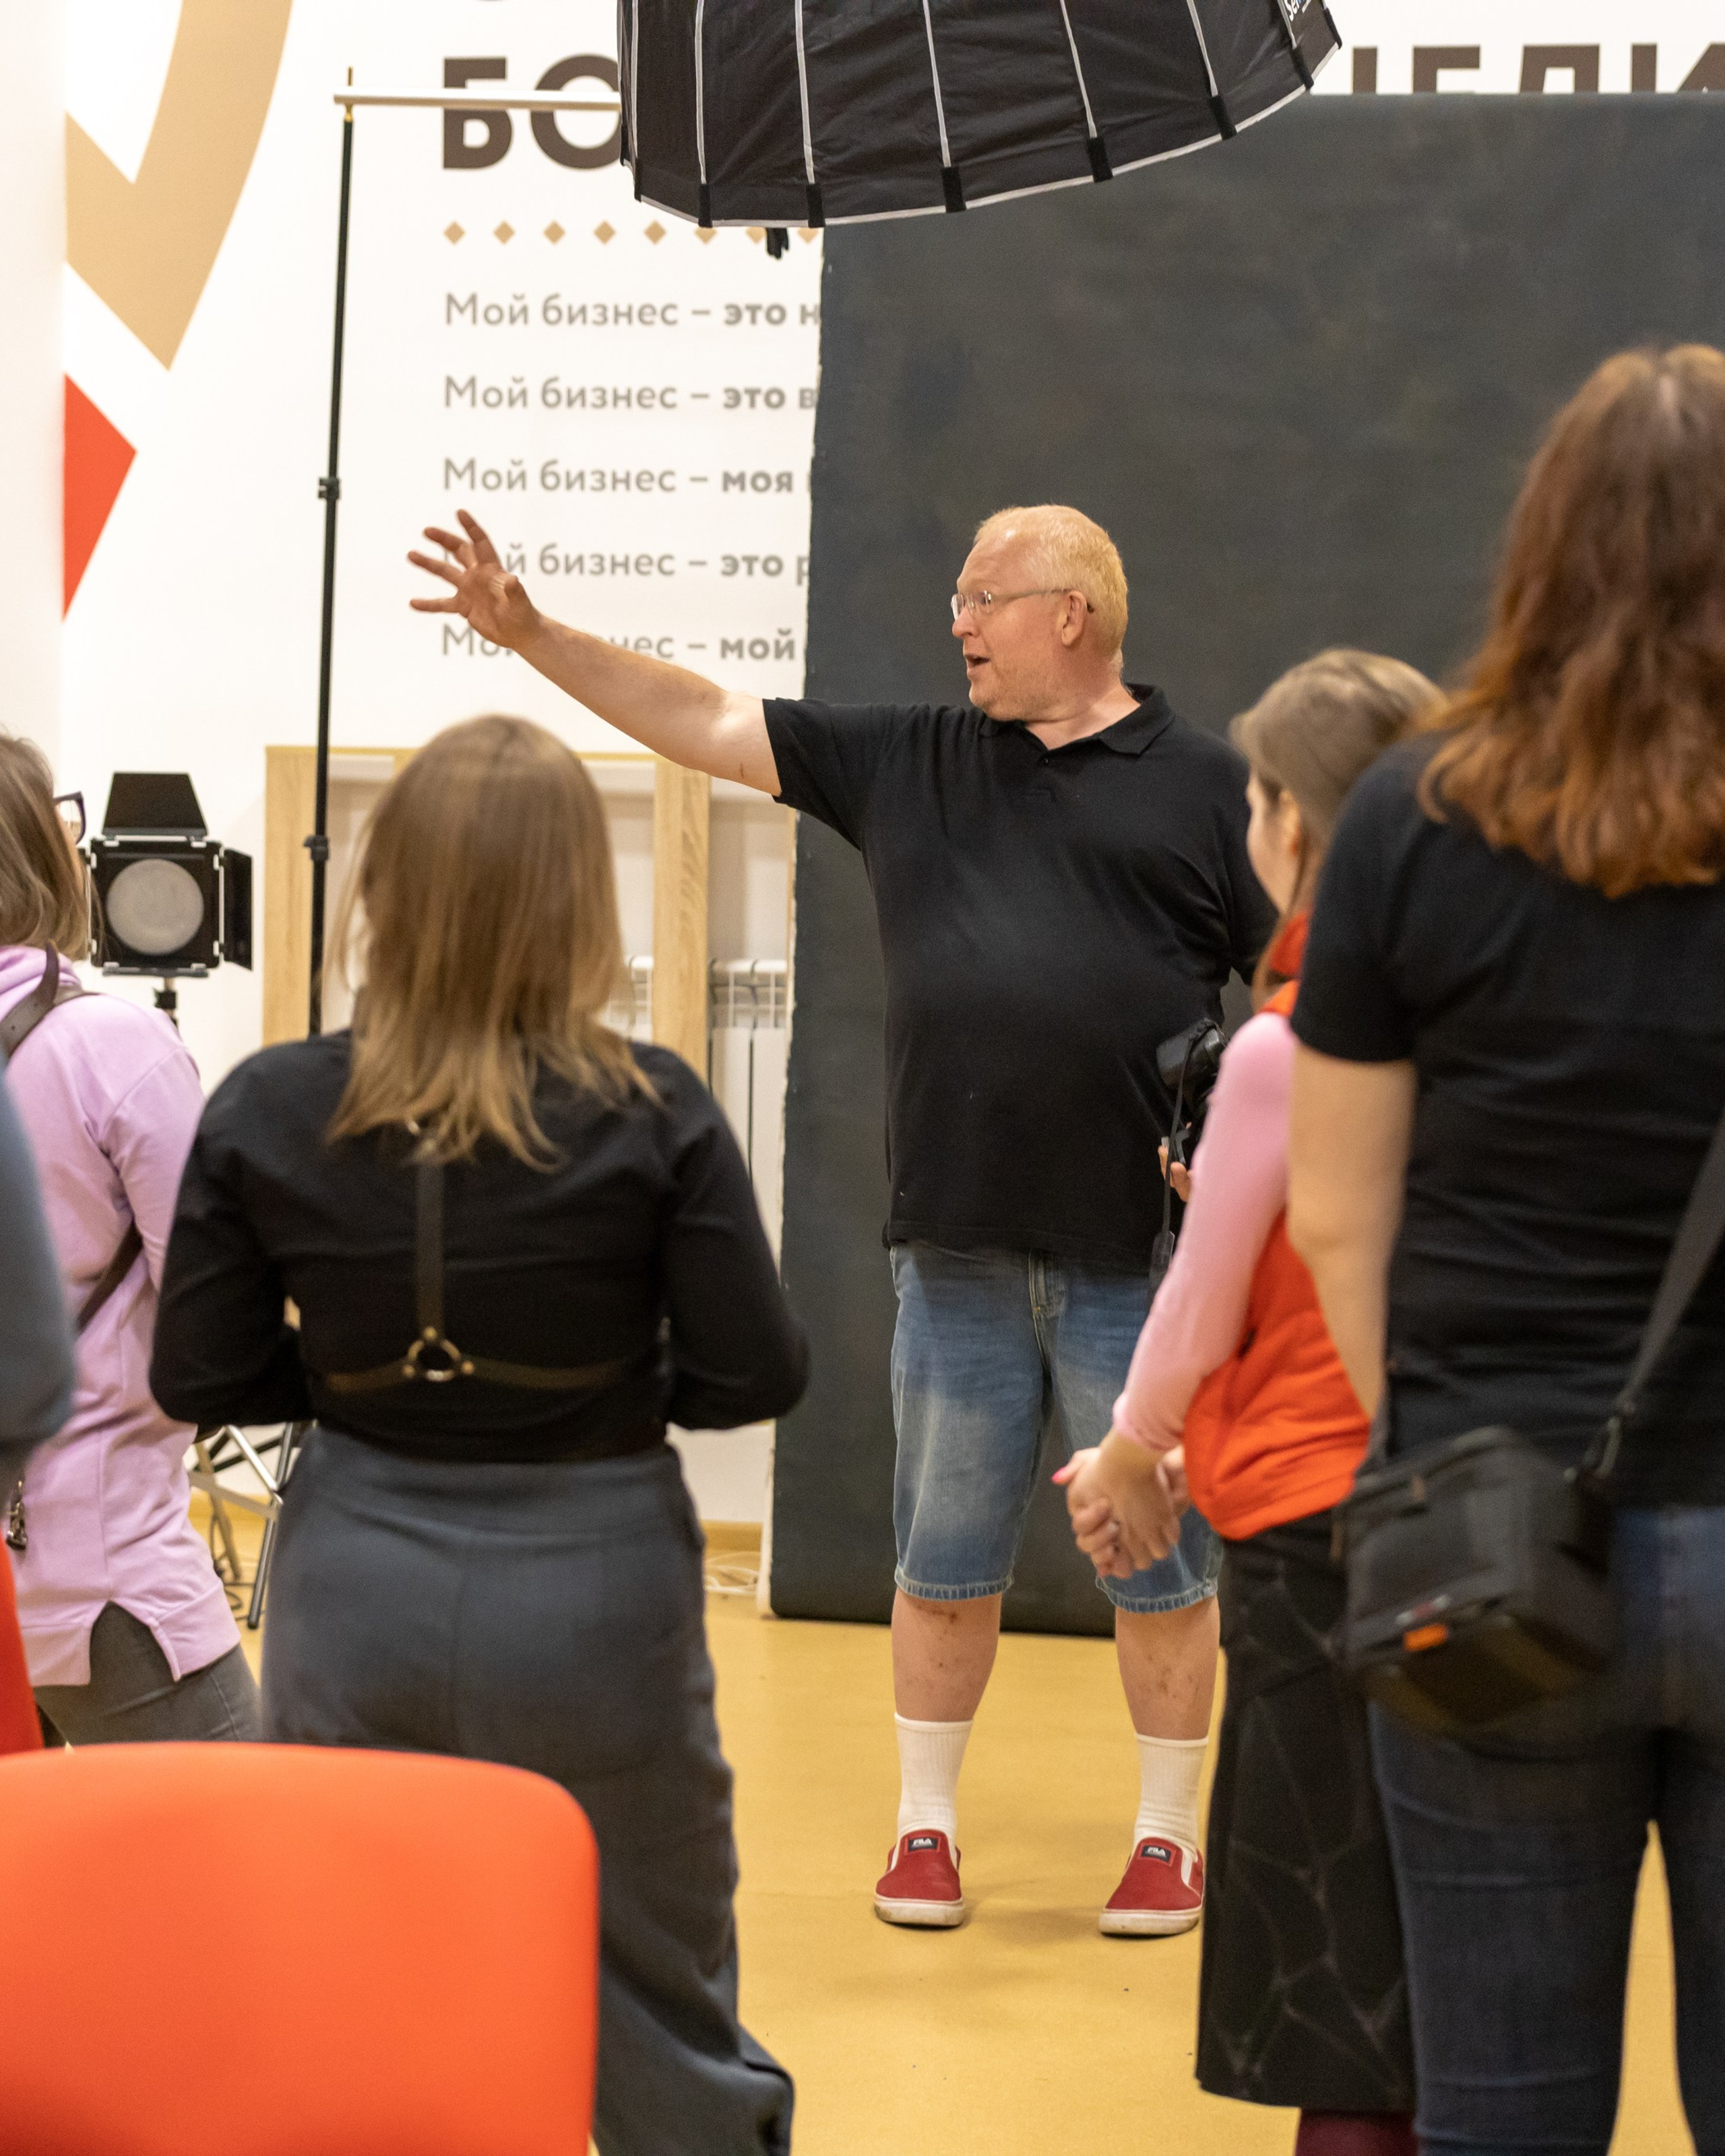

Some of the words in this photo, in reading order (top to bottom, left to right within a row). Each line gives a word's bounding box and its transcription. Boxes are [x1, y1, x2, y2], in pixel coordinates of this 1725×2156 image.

[445, 292, 529, 326] Мой
[541, 292, 679, 327] бизнес
[724, 303, 787, 326] это
[445, 375, 528, 409] Мой
[540, 376, 677, 410] бизнес
[723, 387, 786, 410] это
[443, 457, 528, 491] Мой
[539, 458, 676, 493] бизнес
[722, 470, 793, 493] моя
[538, 543, 675, 577] бизнес
[720, 554, 784, 577] это
[720, 628, 794, 660] мой
[912, 1837, 933, 1846] FILA
